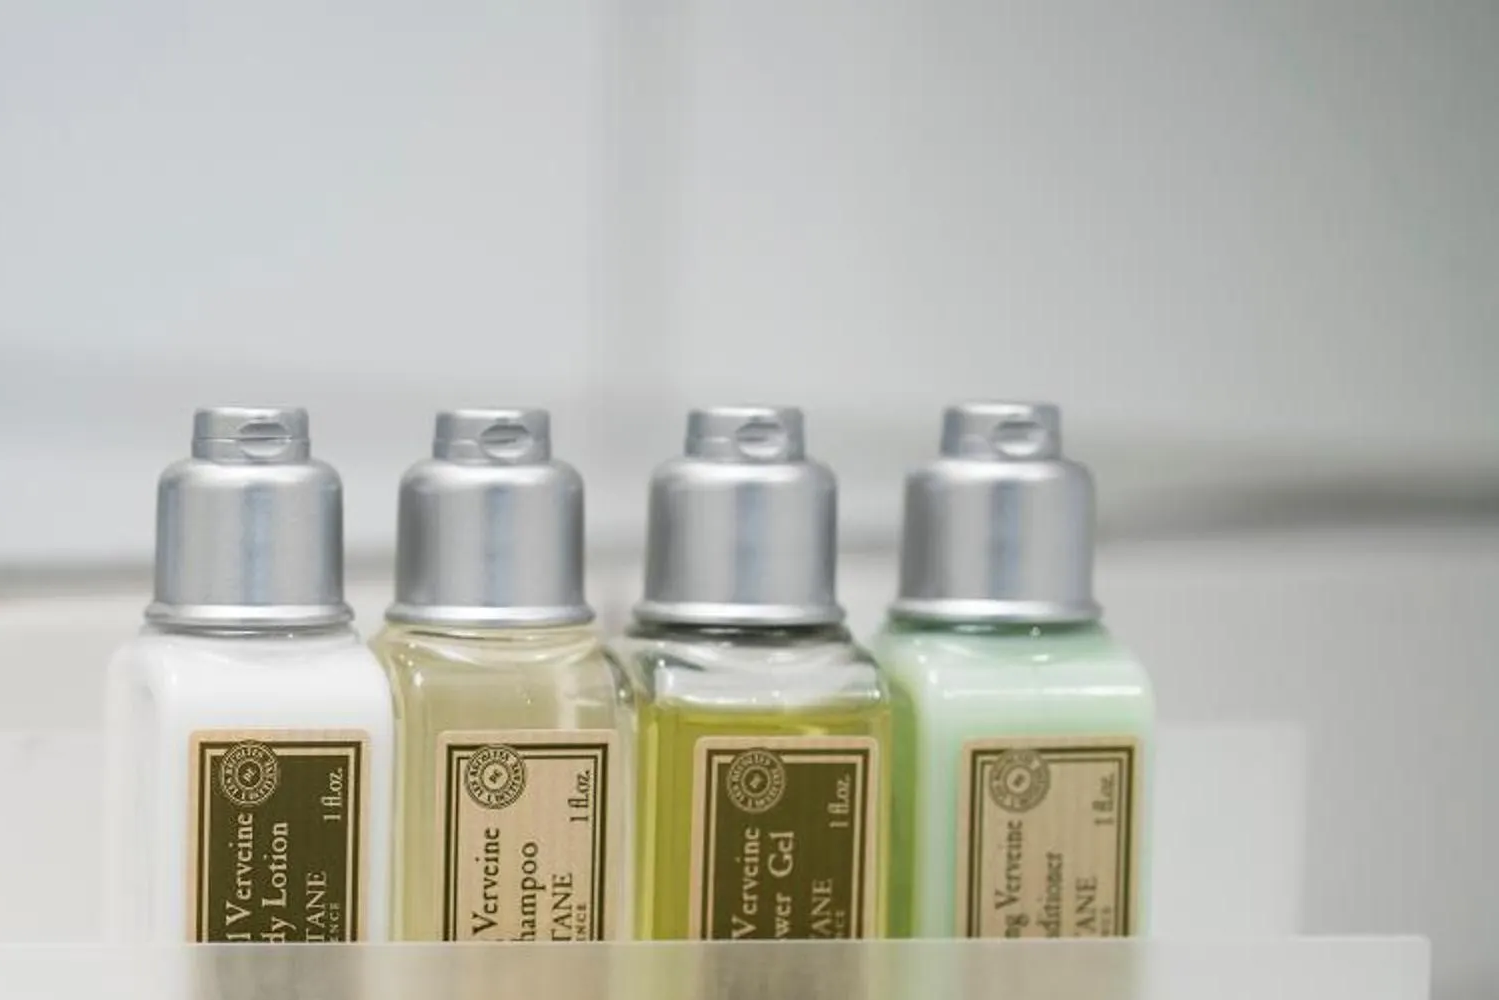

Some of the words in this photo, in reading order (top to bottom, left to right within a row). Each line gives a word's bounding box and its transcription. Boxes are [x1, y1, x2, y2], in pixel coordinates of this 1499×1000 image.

[570, 815, 589, 823] 1
[767, 831, 795, 878] Gel
[226, 813, 253, 926] Verveine
[262, 822, 289, 908] Lotion
[471, 827, 500, 935] Verveine
[731, 827, 761, 940] Verveine
[994, 820, 1023, 910] Verveine
[1074, 876, 1098, 938] ANE
[810, 878, 833, 939] ANE
